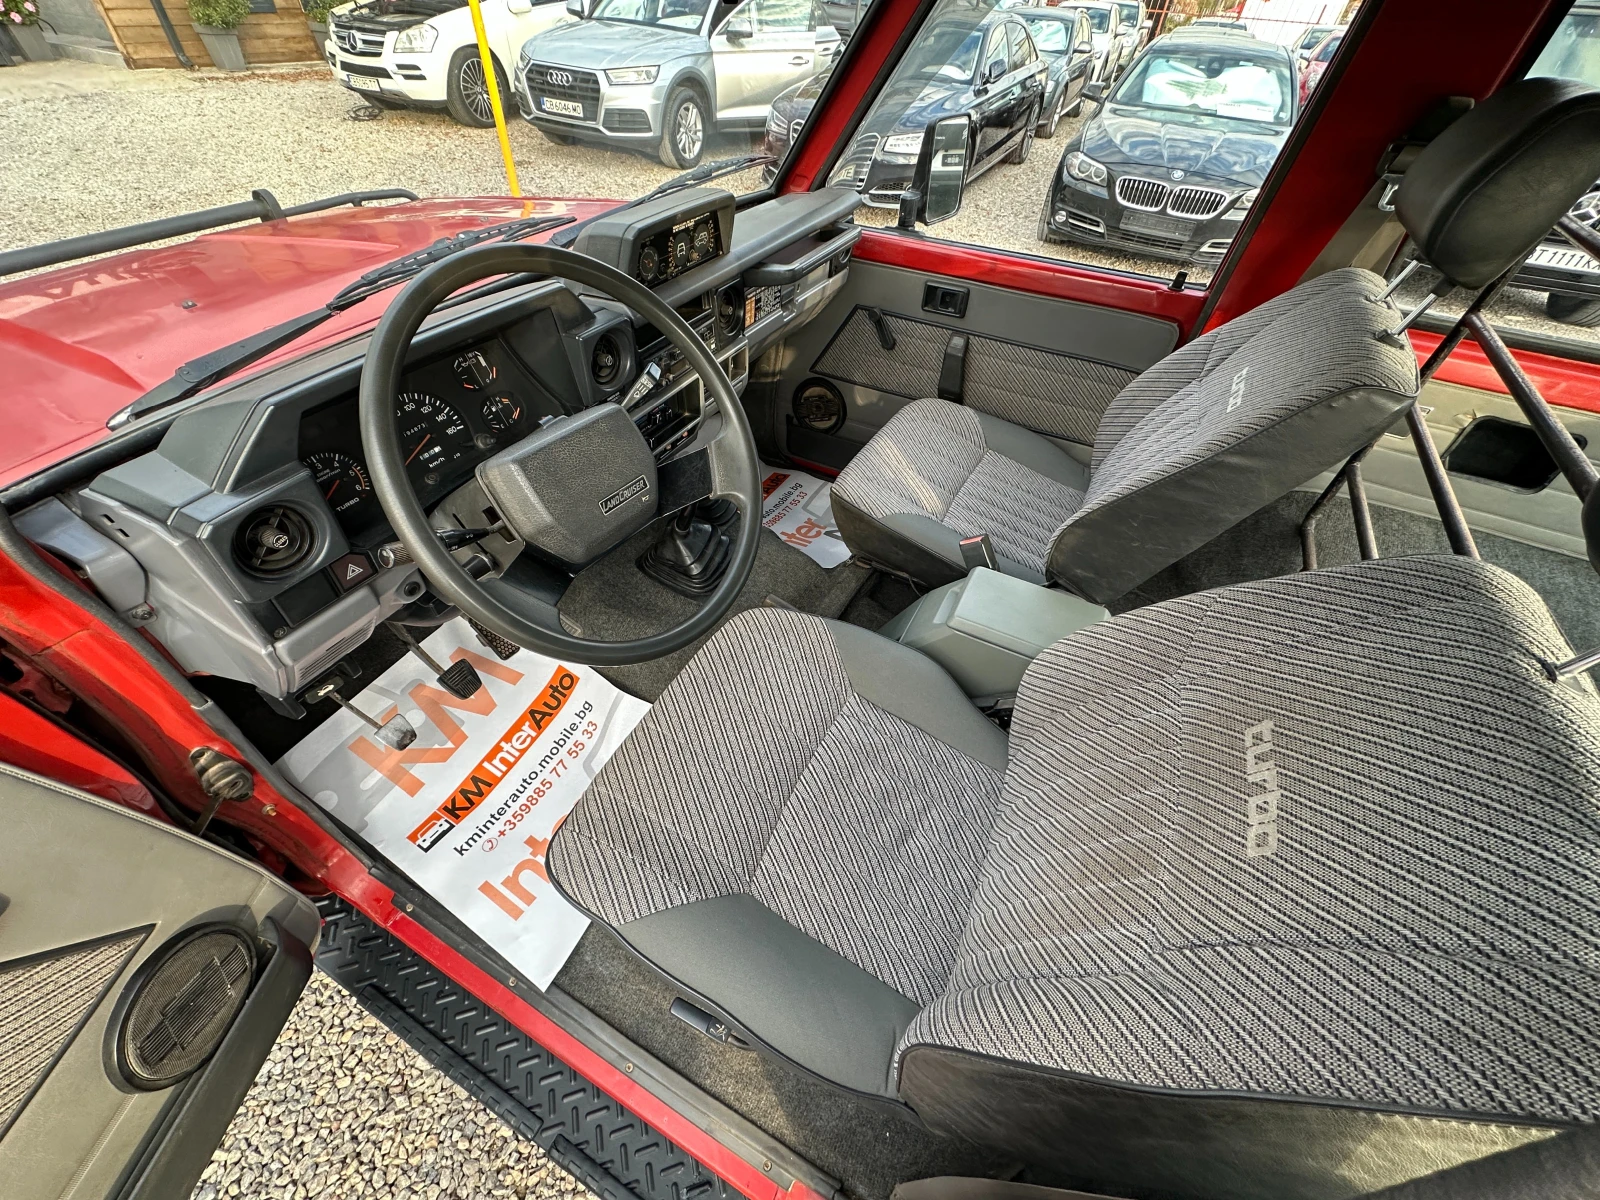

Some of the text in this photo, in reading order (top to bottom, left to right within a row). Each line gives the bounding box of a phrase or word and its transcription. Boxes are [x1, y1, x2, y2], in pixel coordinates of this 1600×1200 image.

[403, 402, 416, 412] 100
[420, 405, 432, 414] 120
[435, 412, 447, 422] 140
[445, 425, 457, 435] 160
[336, 497, 360, 512] TURBO
[442, 673, 575, 820] KM InterAuto
[453, 700, 593, 856] kminterauto.mobile.bg
[498, 720, 598, 838] +359885 77 55 33
